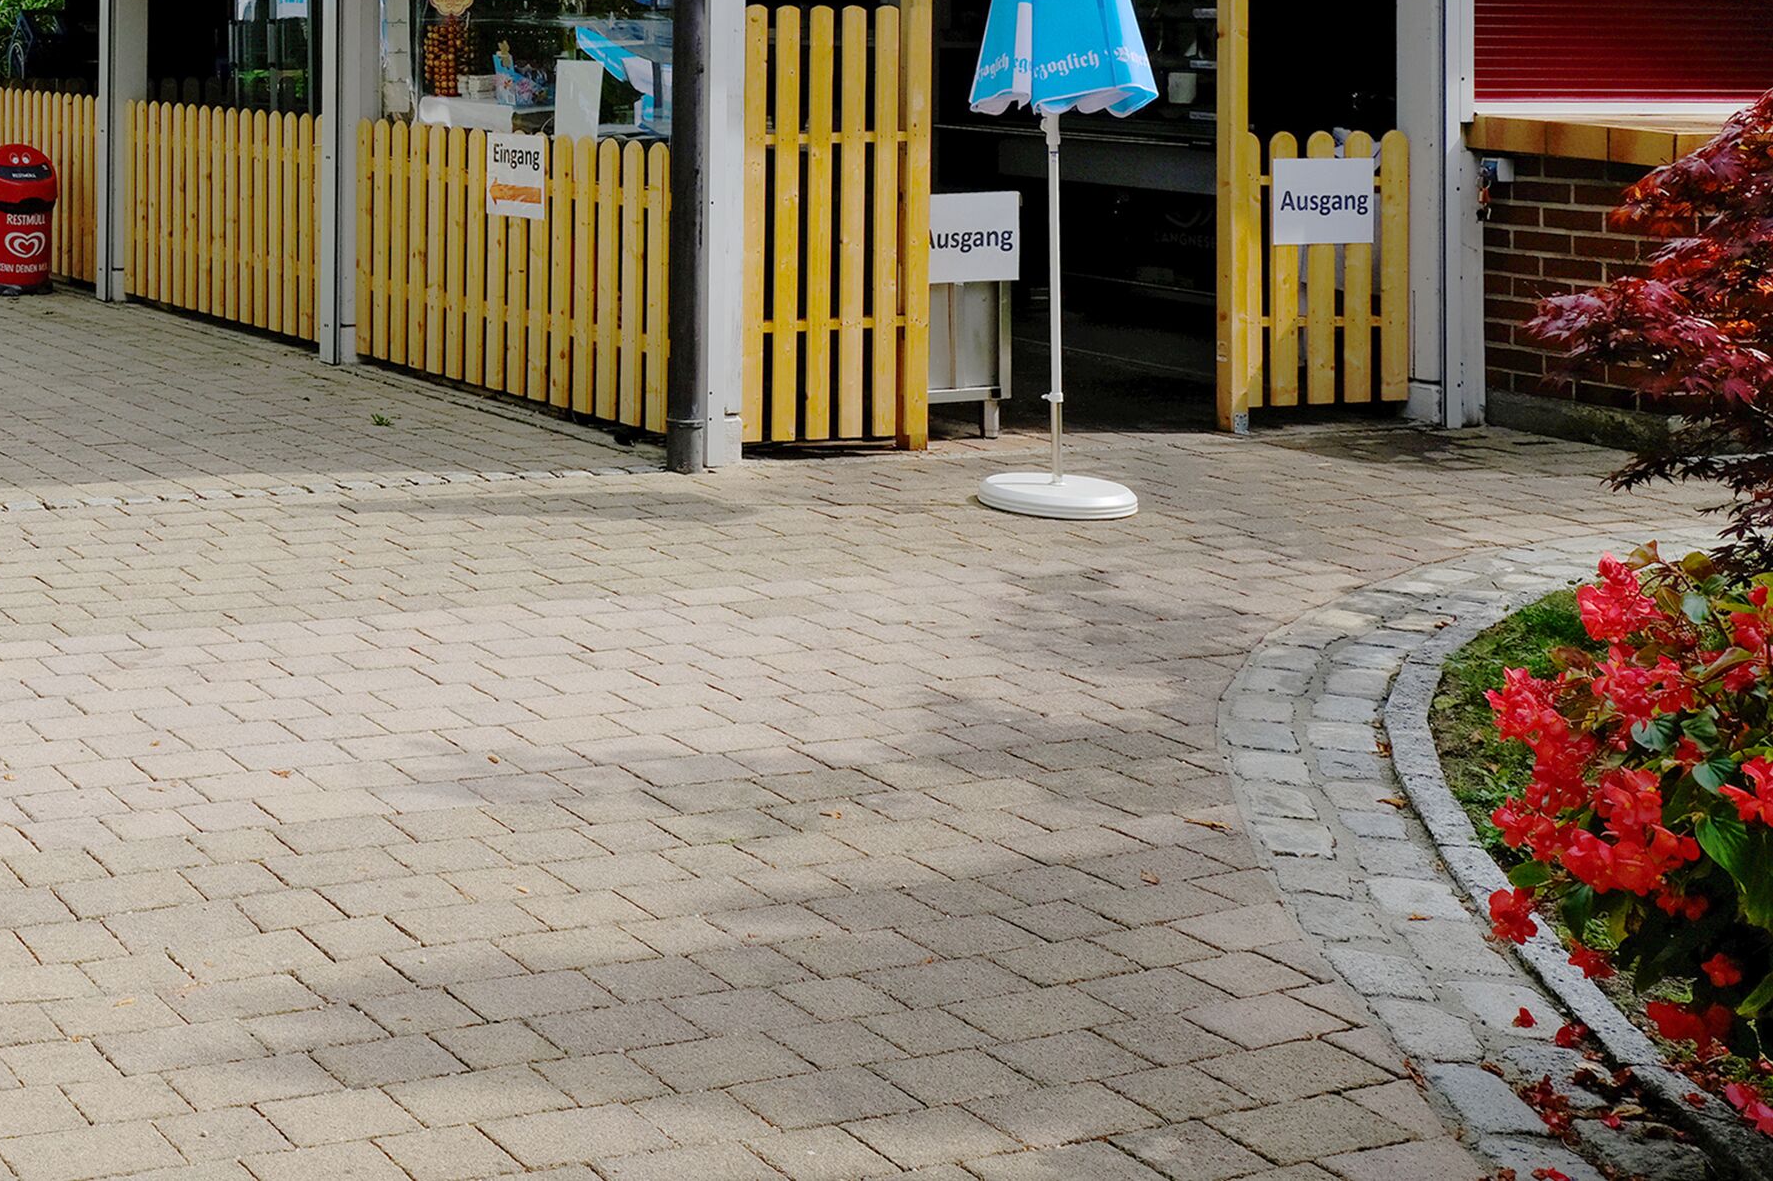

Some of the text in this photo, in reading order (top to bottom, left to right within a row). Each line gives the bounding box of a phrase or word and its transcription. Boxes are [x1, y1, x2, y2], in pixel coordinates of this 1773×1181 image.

[493, 143, 540, 171] Eingang
[1280, 190, 1369, 216] Ausgang
[6, 213, 46, 226] RESTMÜLL
